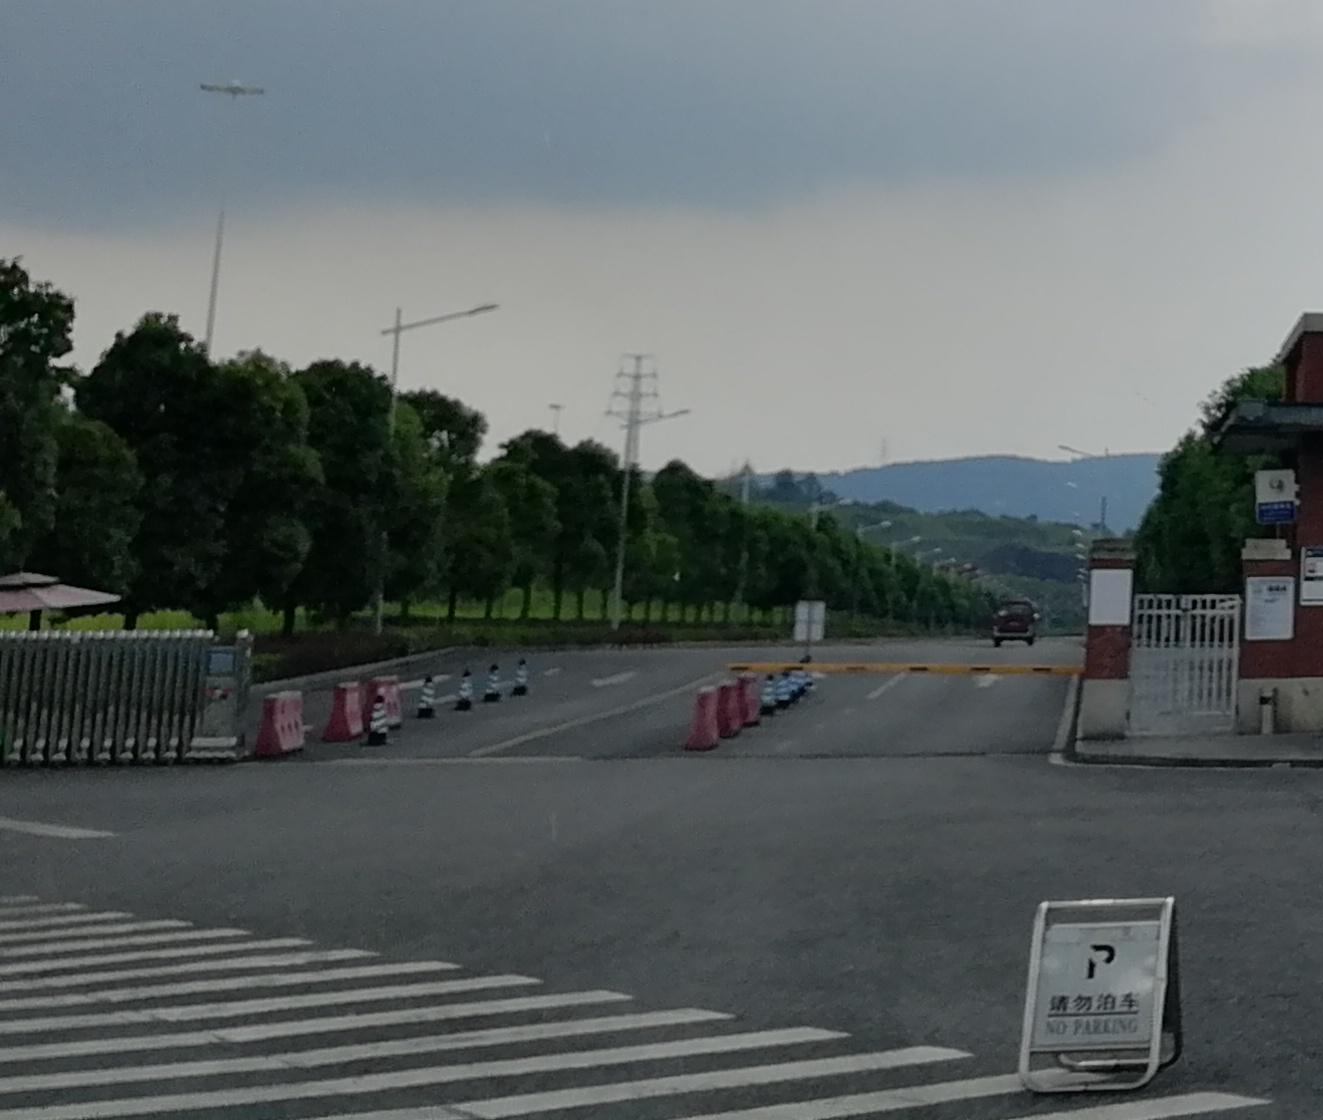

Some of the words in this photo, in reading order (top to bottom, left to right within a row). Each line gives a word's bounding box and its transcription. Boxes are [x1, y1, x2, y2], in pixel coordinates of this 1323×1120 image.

[1049, 992, 1139, 1012] 请勿泊车
[1073, 1017, 1138, 1035] PARKING
